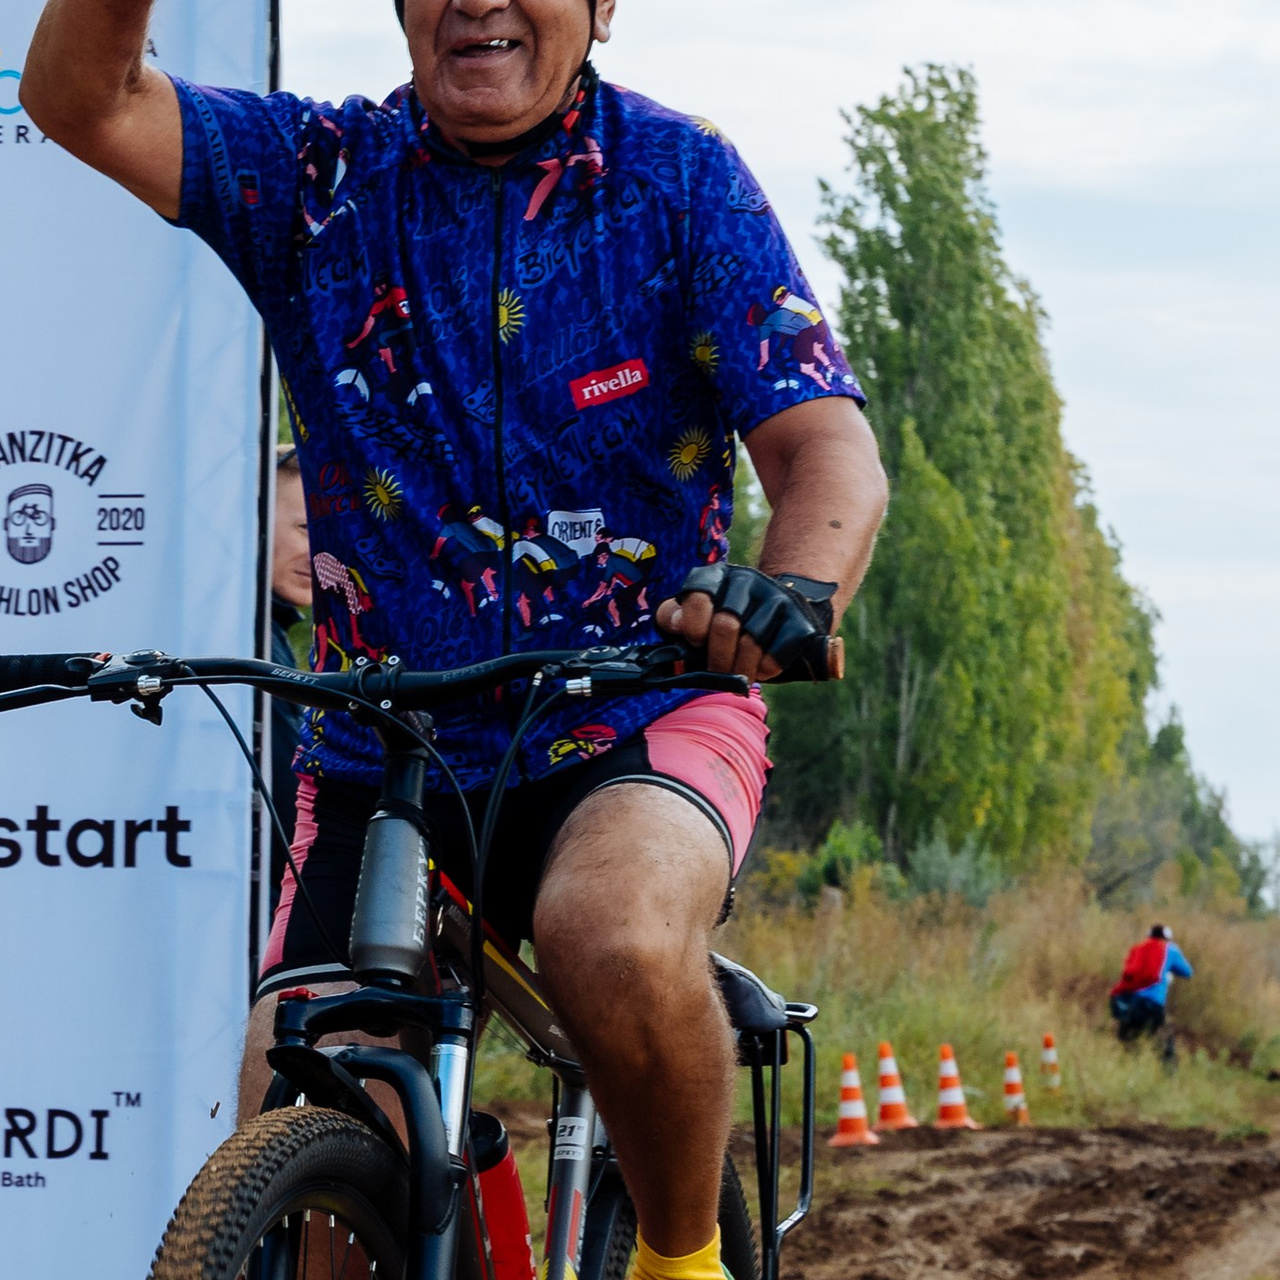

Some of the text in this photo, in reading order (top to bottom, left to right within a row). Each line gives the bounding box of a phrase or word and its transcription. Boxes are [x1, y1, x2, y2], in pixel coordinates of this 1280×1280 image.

[581, 367, 643, 400] rivella
[96, 506, 146, 532] 2020
[63, 555, 122, 609] SHOP
[0, 1170, 47, 1189] Bath
